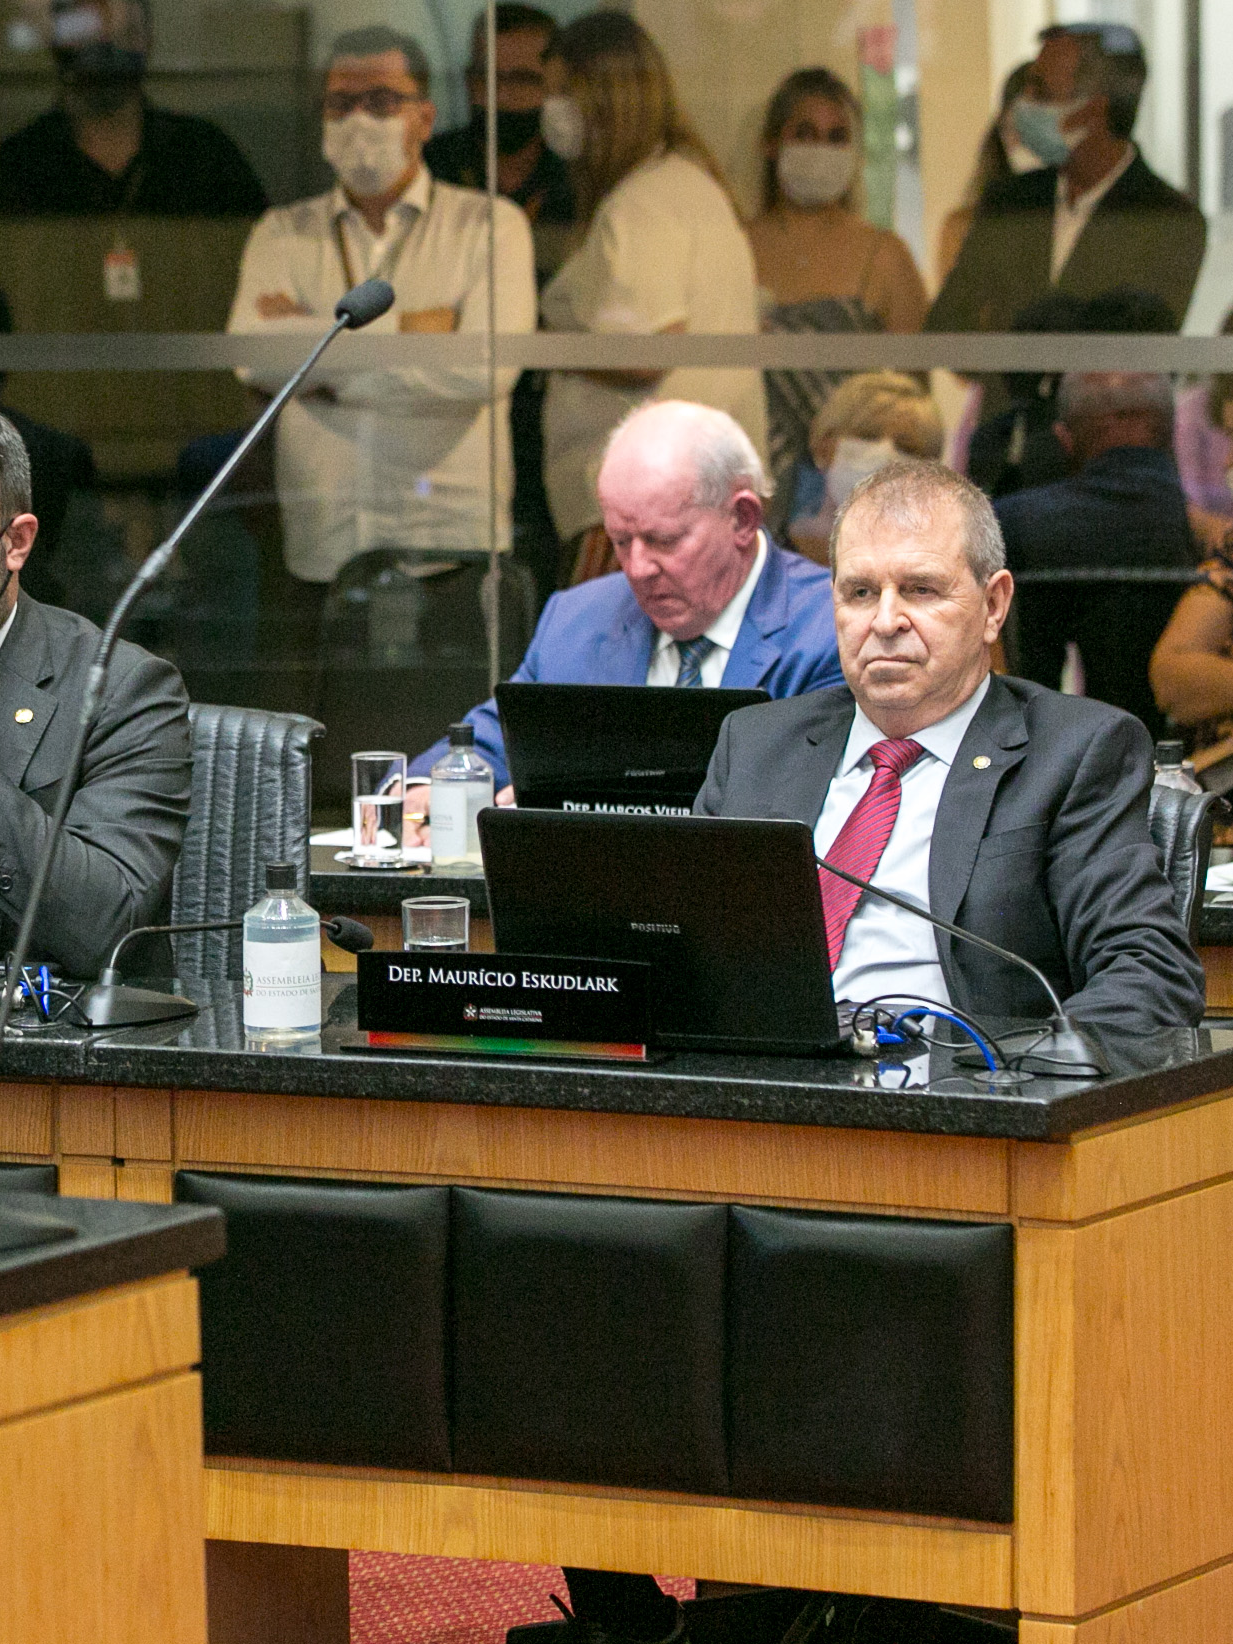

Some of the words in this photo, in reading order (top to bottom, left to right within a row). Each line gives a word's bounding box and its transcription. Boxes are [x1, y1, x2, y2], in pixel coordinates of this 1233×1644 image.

[563, 800, 590, 812] DEP
[595, 802, 652, 815] MARCOS
[654, 804, 691, 816] VIEIR
[256, 976, 310, 984] ASSEMBLEIA
[388, 965, 423, 983] DEP.
[428, 967, 516, 988] MAURÍCIO
[521, 971, 620, 993] ESKUDLARK
[268, 989, 298, 997] ESTADO
[299, 988, 308, 996] DE
